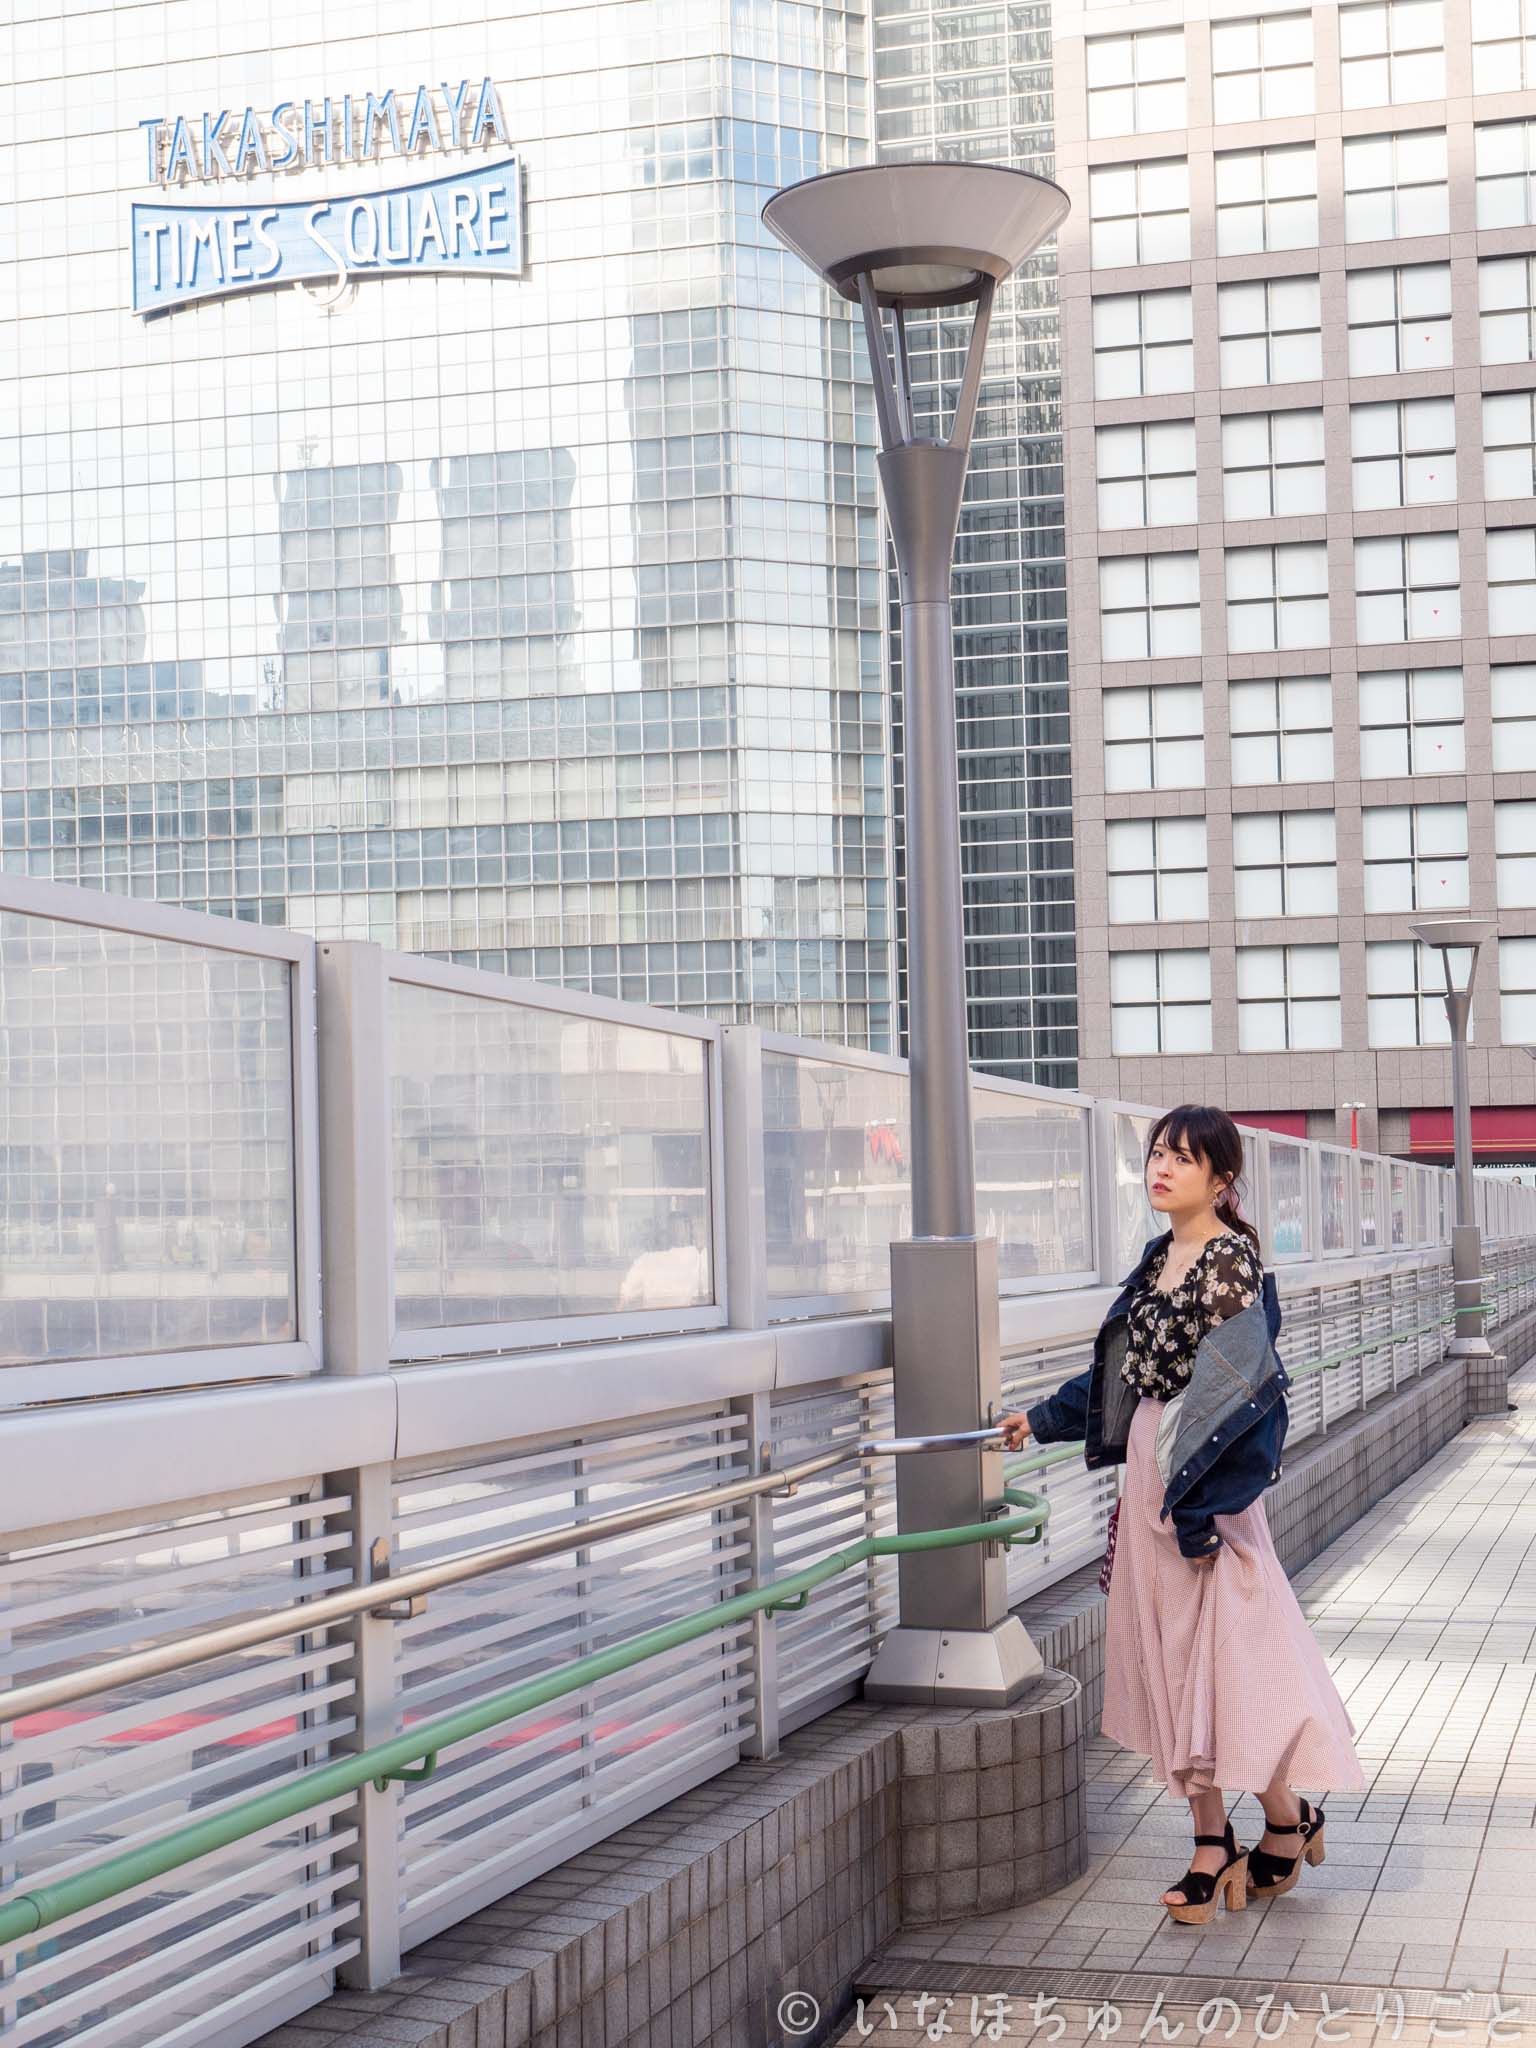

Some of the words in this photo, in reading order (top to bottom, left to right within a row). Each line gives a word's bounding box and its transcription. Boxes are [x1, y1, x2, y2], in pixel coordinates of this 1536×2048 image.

[139, 76, 508, 183] TAKASHIMAYA
[140, 207, 281, 290] TIMES
[304, 183, 508, 305] SQUARE
